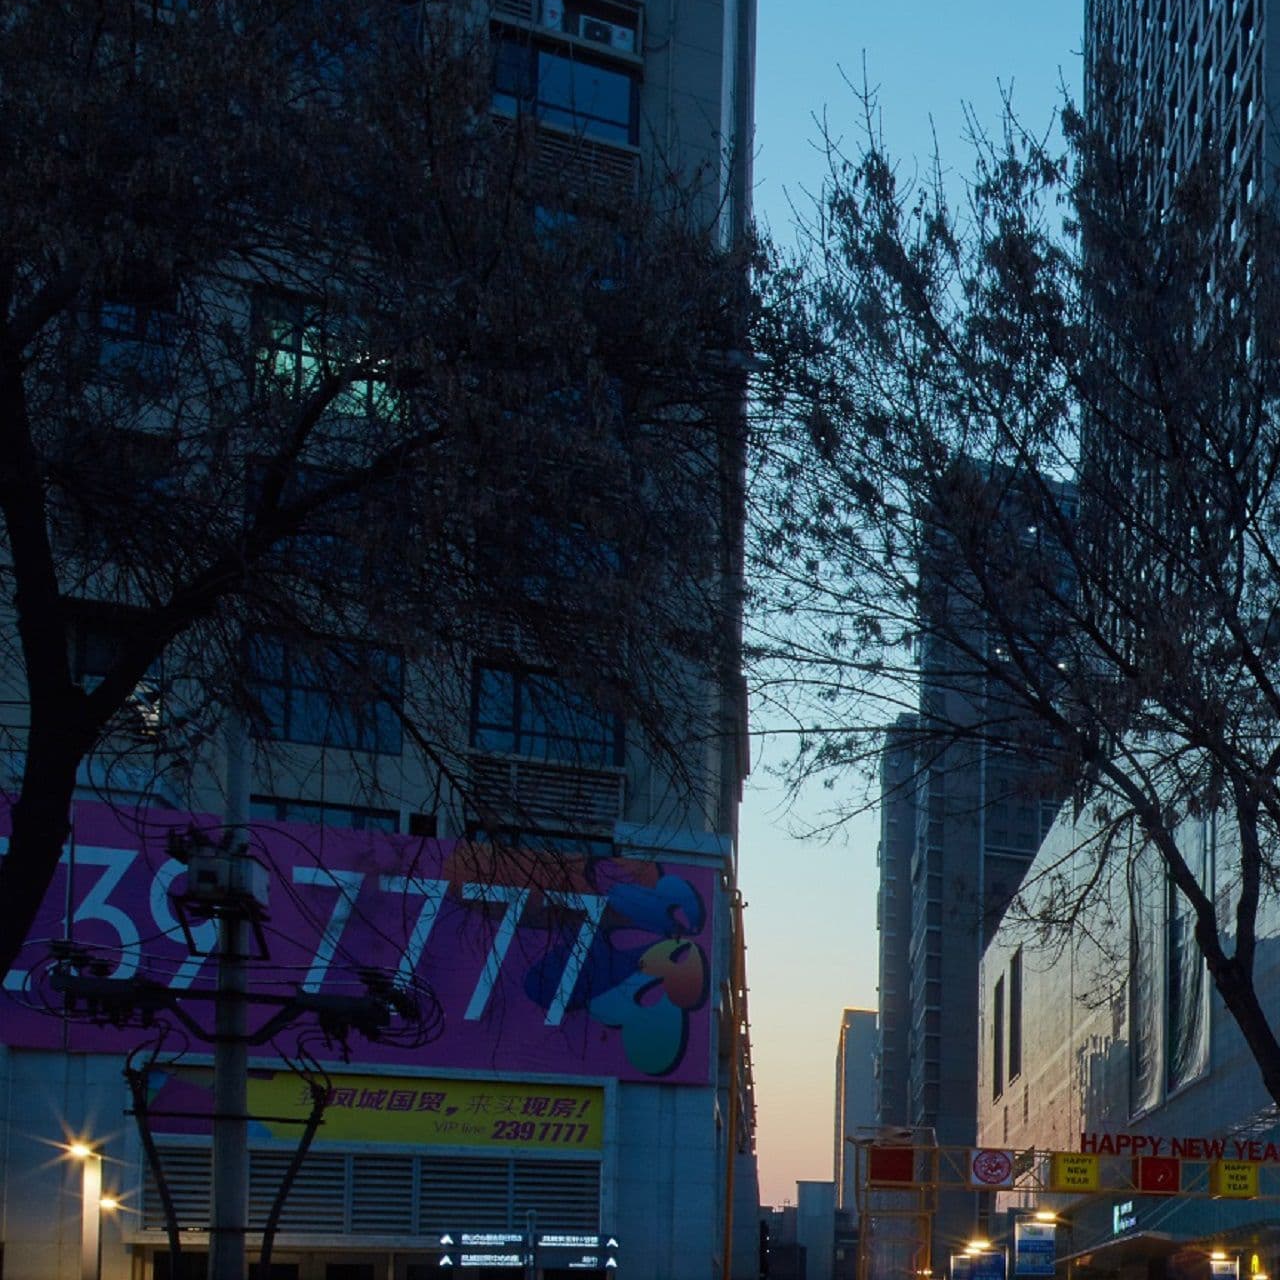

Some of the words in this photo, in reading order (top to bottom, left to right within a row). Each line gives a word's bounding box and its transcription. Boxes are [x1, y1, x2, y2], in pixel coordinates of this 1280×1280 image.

[1080, 1132, 1163, 1157] HAPPY
[1171, 1136, 1227, 1160] NEW
[1067, 1167, 1088, 1175] NEW
[1065, 1177, 1089, 1185] YEAR
[1229, 1173, 1247, 1181] NEW
[1227, 1183, 1250, 1191] YEAR
